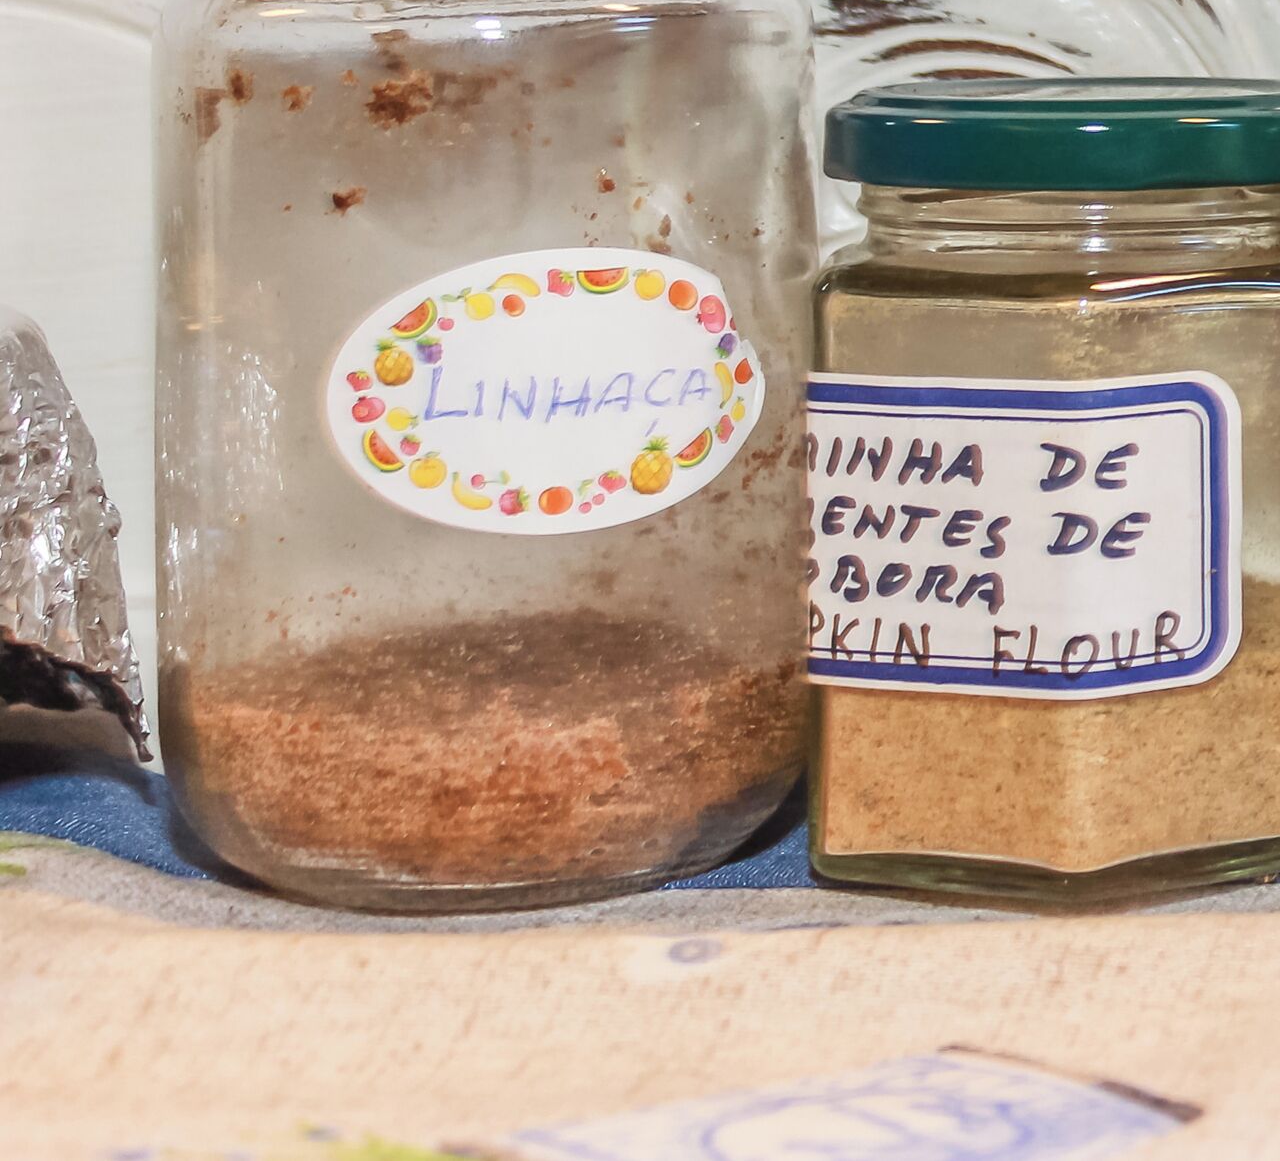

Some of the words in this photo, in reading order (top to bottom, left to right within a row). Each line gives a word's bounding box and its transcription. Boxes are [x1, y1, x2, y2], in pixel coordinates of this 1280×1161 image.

[1039, 442, 1140, 492] DE
[806, 494, 1012, 559] ENTES
[1046, 511, 1152, 558] DE
[991, 609, 1187, 682] FLOUR
